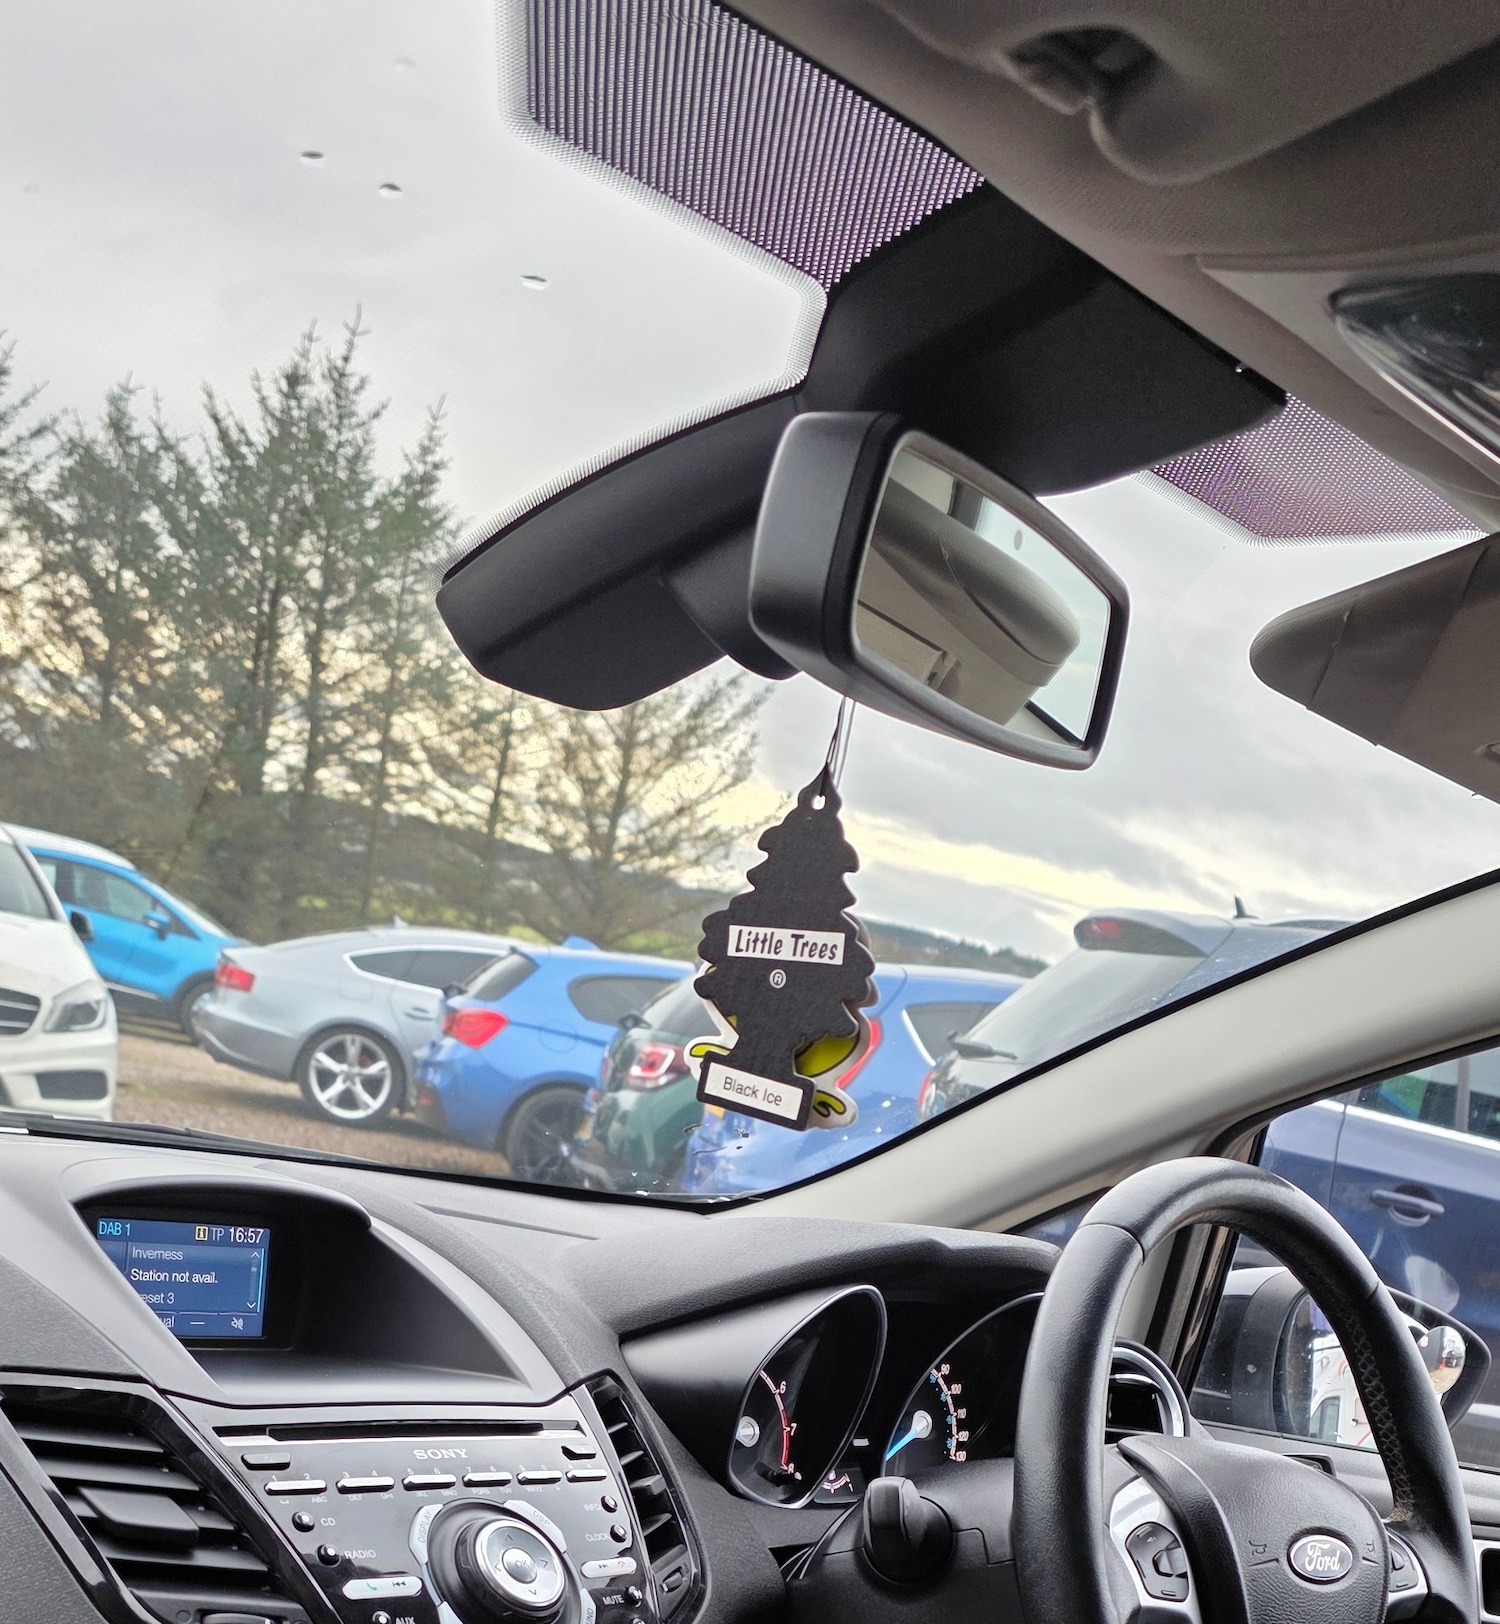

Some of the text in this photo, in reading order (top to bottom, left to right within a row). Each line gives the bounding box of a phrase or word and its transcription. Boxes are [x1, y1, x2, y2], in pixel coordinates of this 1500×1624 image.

[735, 929, 838, 960] Little Trees
[722, 1076, 783, 1106] Black Ice
[99, 1221, 131, 1236] DAB 1
[211, 1227, 264, 1244] TP 16:57
[132, 1246, 184, 1261] Inverness
[130, 1268, 219, 1284] Station not avail.
[166, 1292, 175, 1305] 3
[779, 1380, 787, 1394] 6
[790, 1422, 798, 1436] 7
[413, 1448, 469, 1460] SONY
[320, 1517, 337, 1527] CD
[417, 1508, 434, 1544] DISPLAY
[344, 1549, 377, 1560] RADIO
[1304, 1541, 1341, 1572] Ford
[514, 1559, 529, 1568] OK
[602, 1594, 625, 1606] MUTE
